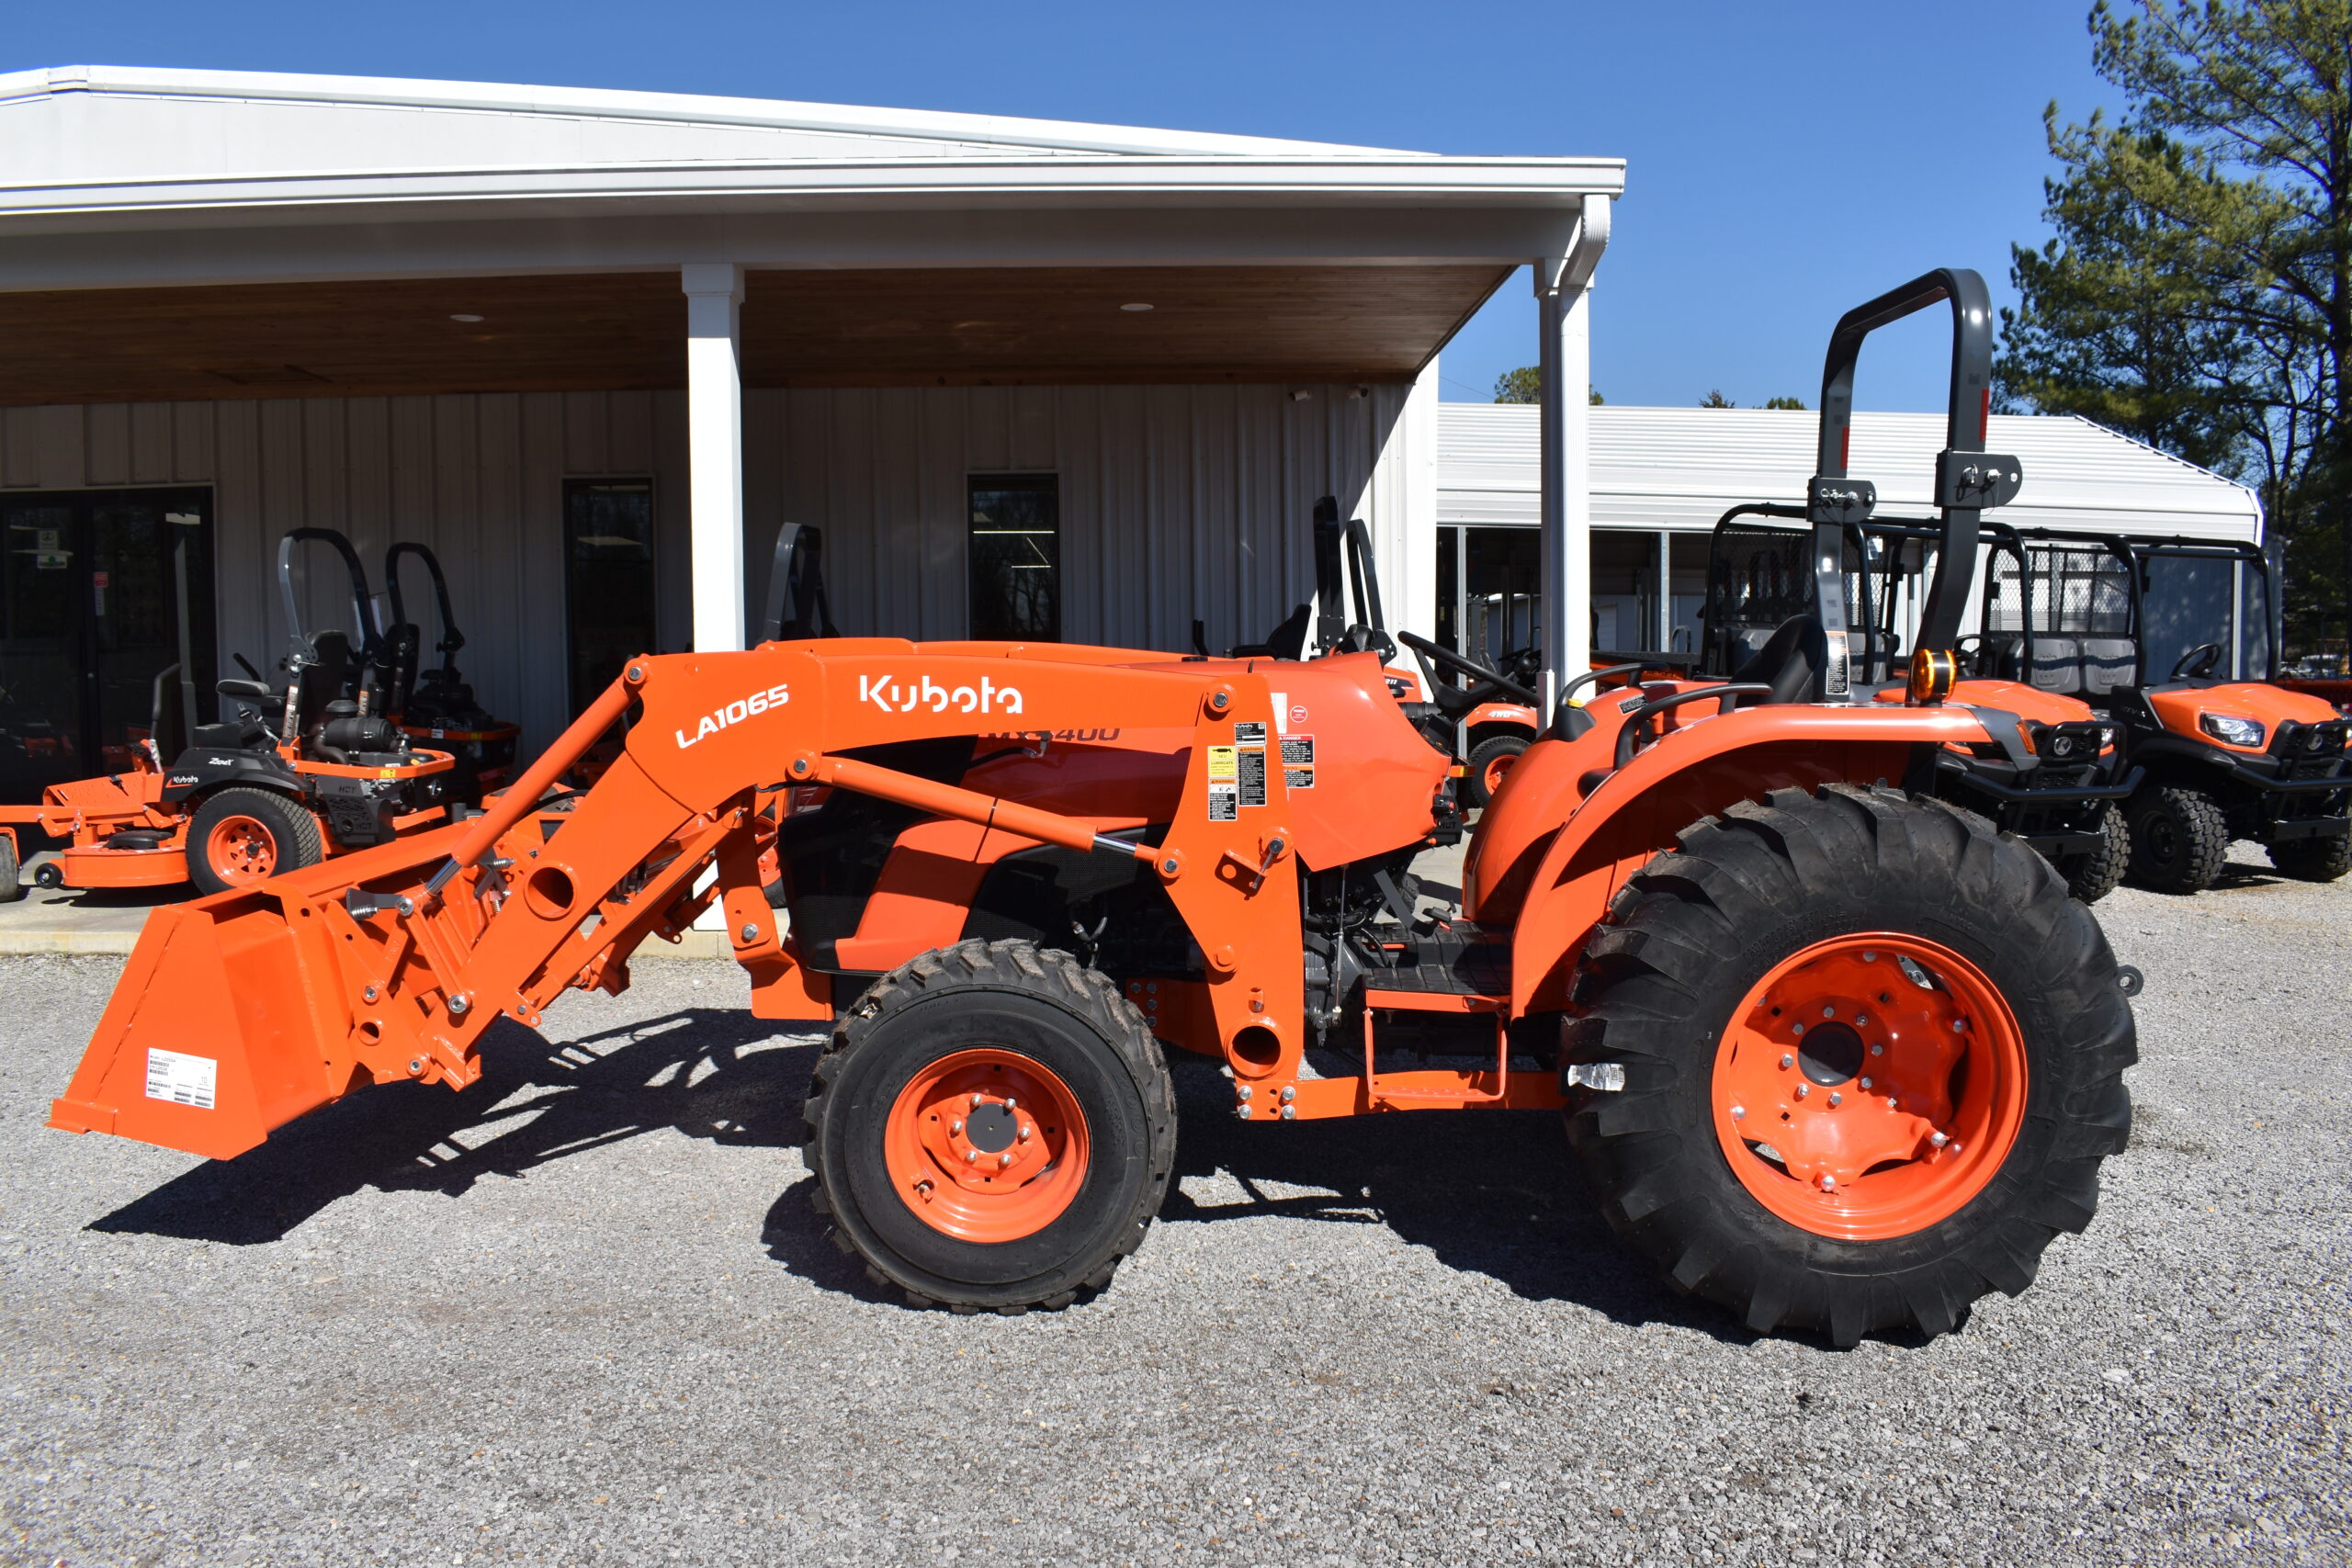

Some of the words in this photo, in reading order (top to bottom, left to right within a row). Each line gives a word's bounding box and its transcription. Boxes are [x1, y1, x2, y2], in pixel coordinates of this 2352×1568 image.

[859, 674, 1023, 714] Kubota
[675, 683, 789, 750] LA1065
[988, 728, 1120, 748] MX400
[173, 775, 199, 784] Kubota
[338, 785, 356, 794] HOT
